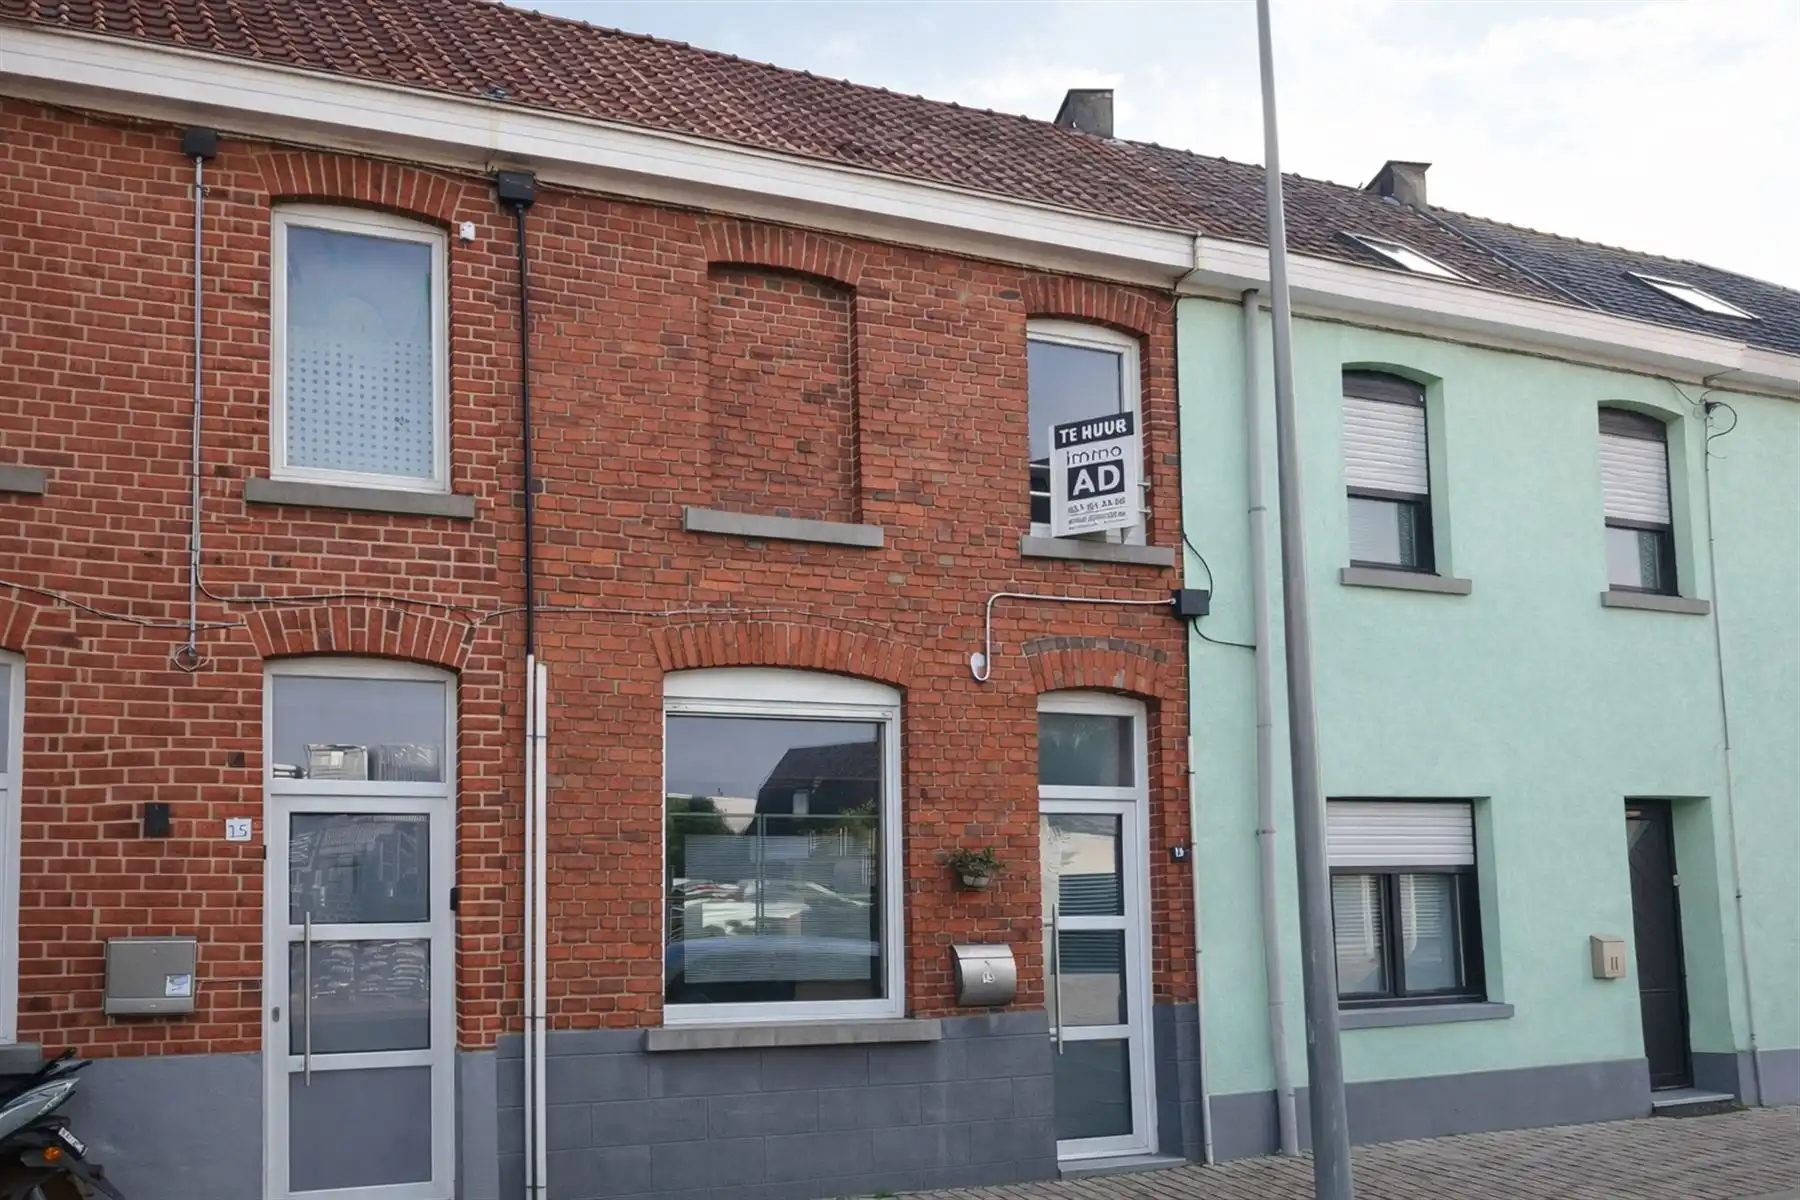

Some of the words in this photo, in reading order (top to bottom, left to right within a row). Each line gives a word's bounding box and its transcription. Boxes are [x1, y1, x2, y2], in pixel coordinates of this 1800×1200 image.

[1059, 427, 1077, 443] TE
[1081, 418, 1127, 440] HUUR
[1067, 446, 1122, 466] immo
[1072, 464, 1121, 496] AD
